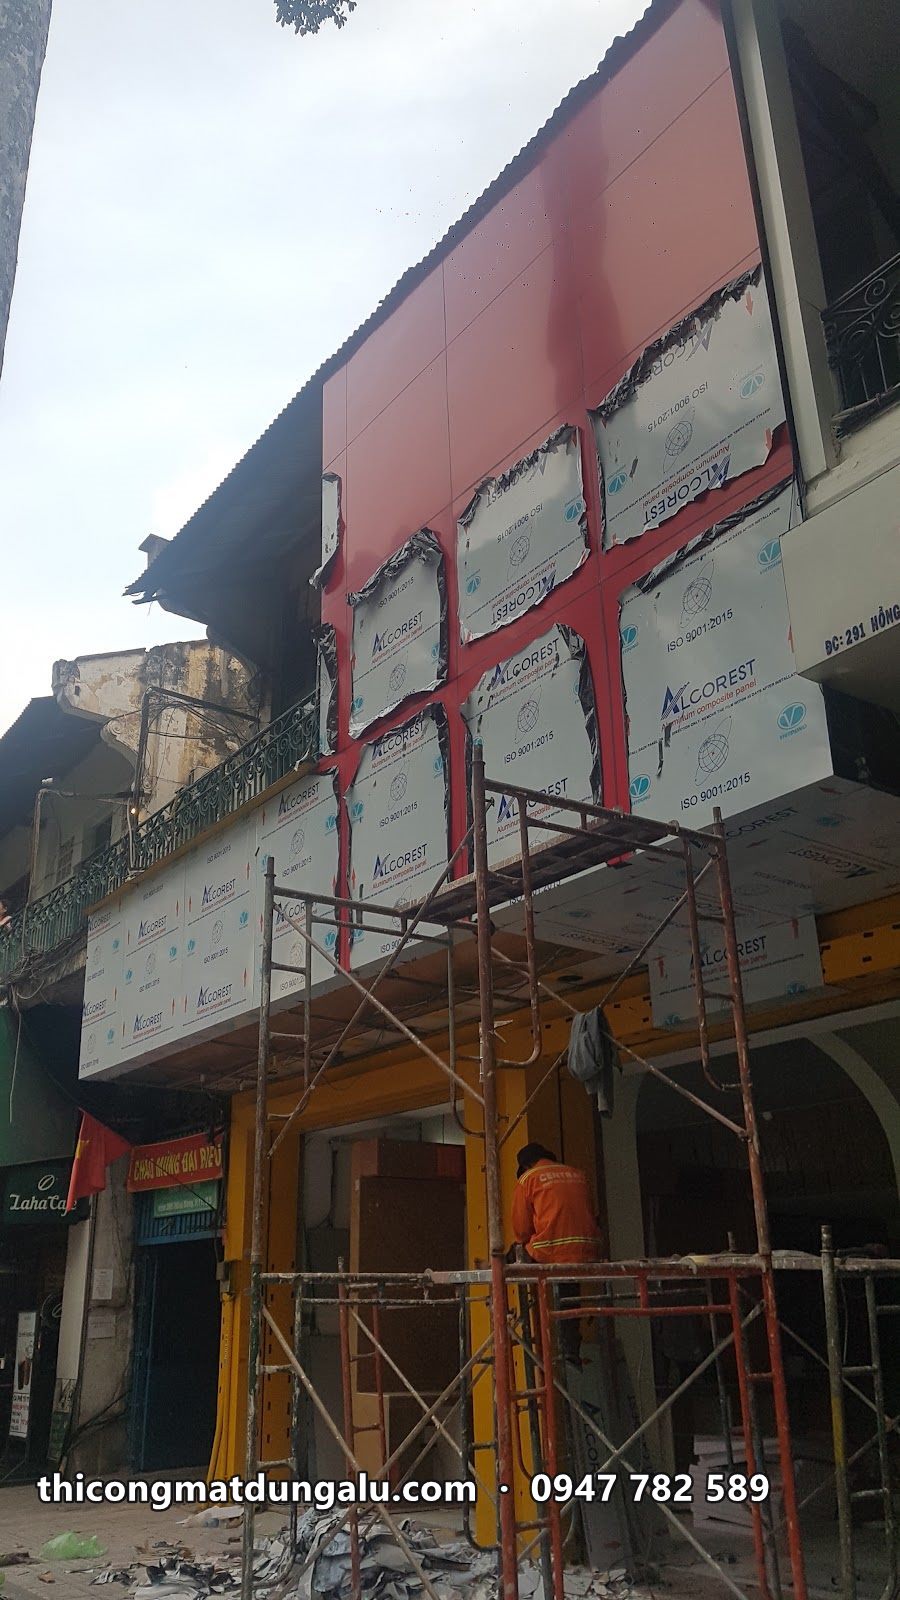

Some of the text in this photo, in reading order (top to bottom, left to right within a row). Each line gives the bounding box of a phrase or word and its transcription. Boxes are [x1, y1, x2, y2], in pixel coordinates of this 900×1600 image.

[647, 381, 708, 433] ISO 9001:2015
[660, 467, 696, 494] composite
[530, 503, 543, 517] ISO
[372, 610, 423, 658] ALCOREST
[667, 638, 684, 652] ISO
[685, 608, 734, 642] 9001:2015
[491, 638, 559, 691] ALCOREST
[660, 659, 756, 721] ALCOREST
[696, 690, 734, 716] composite
[735, 678, 757, 697] panel
[504, 730, 554, 765] ISO 9001:2015
[279, 782, 320, 816] ALCOREST
[680, 772, 751, 811] ISO 9001:2015
[379, 801, 418, 829] ISO 9001:2015
[373, 843, 428, 881] ALCOREST
[202, 878, 236, 906] ALCOREST
[138, 915, 167, 939] ALCOREST
[197, 984, 233, 1008] ALCOREST
[133, 1012, 163, 1032] ALCOREST
[9, 1193, 47, 1211] Laha
